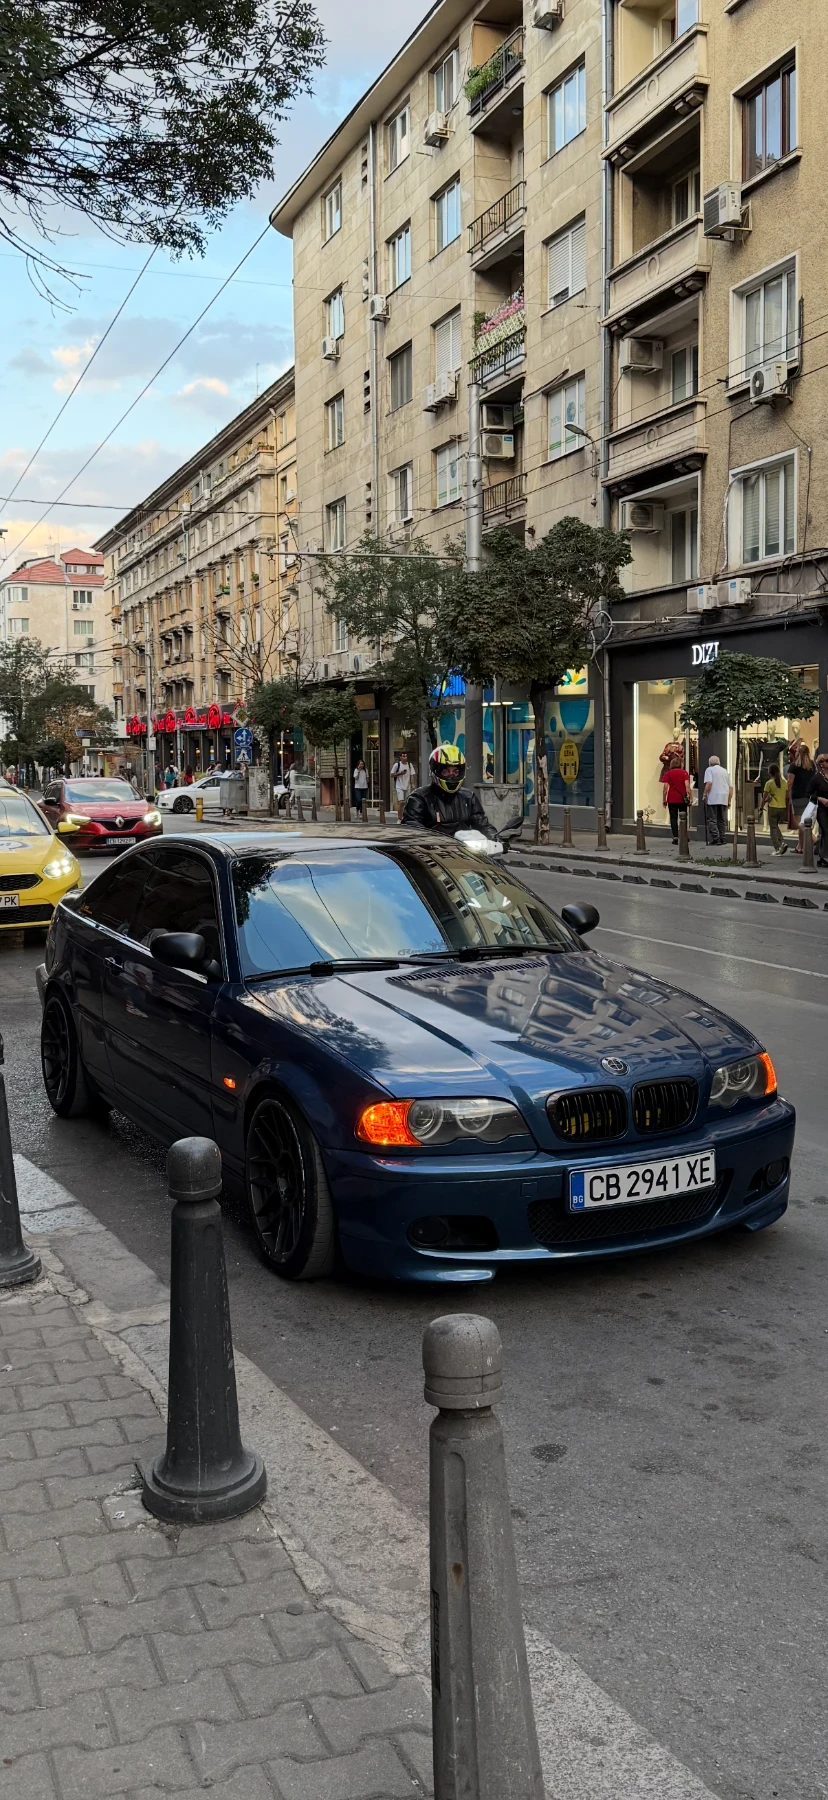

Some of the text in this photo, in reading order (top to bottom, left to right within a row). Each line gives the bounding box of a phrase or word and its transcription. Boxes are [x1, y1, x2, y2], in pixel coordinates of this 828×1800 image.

[691, 641, 720, 665] DIZI
[4, 896, 17, 906] PK
[589, 1156, 711, 1202] CB 2941 XE
[572, 1195, 584, 1203] BG
